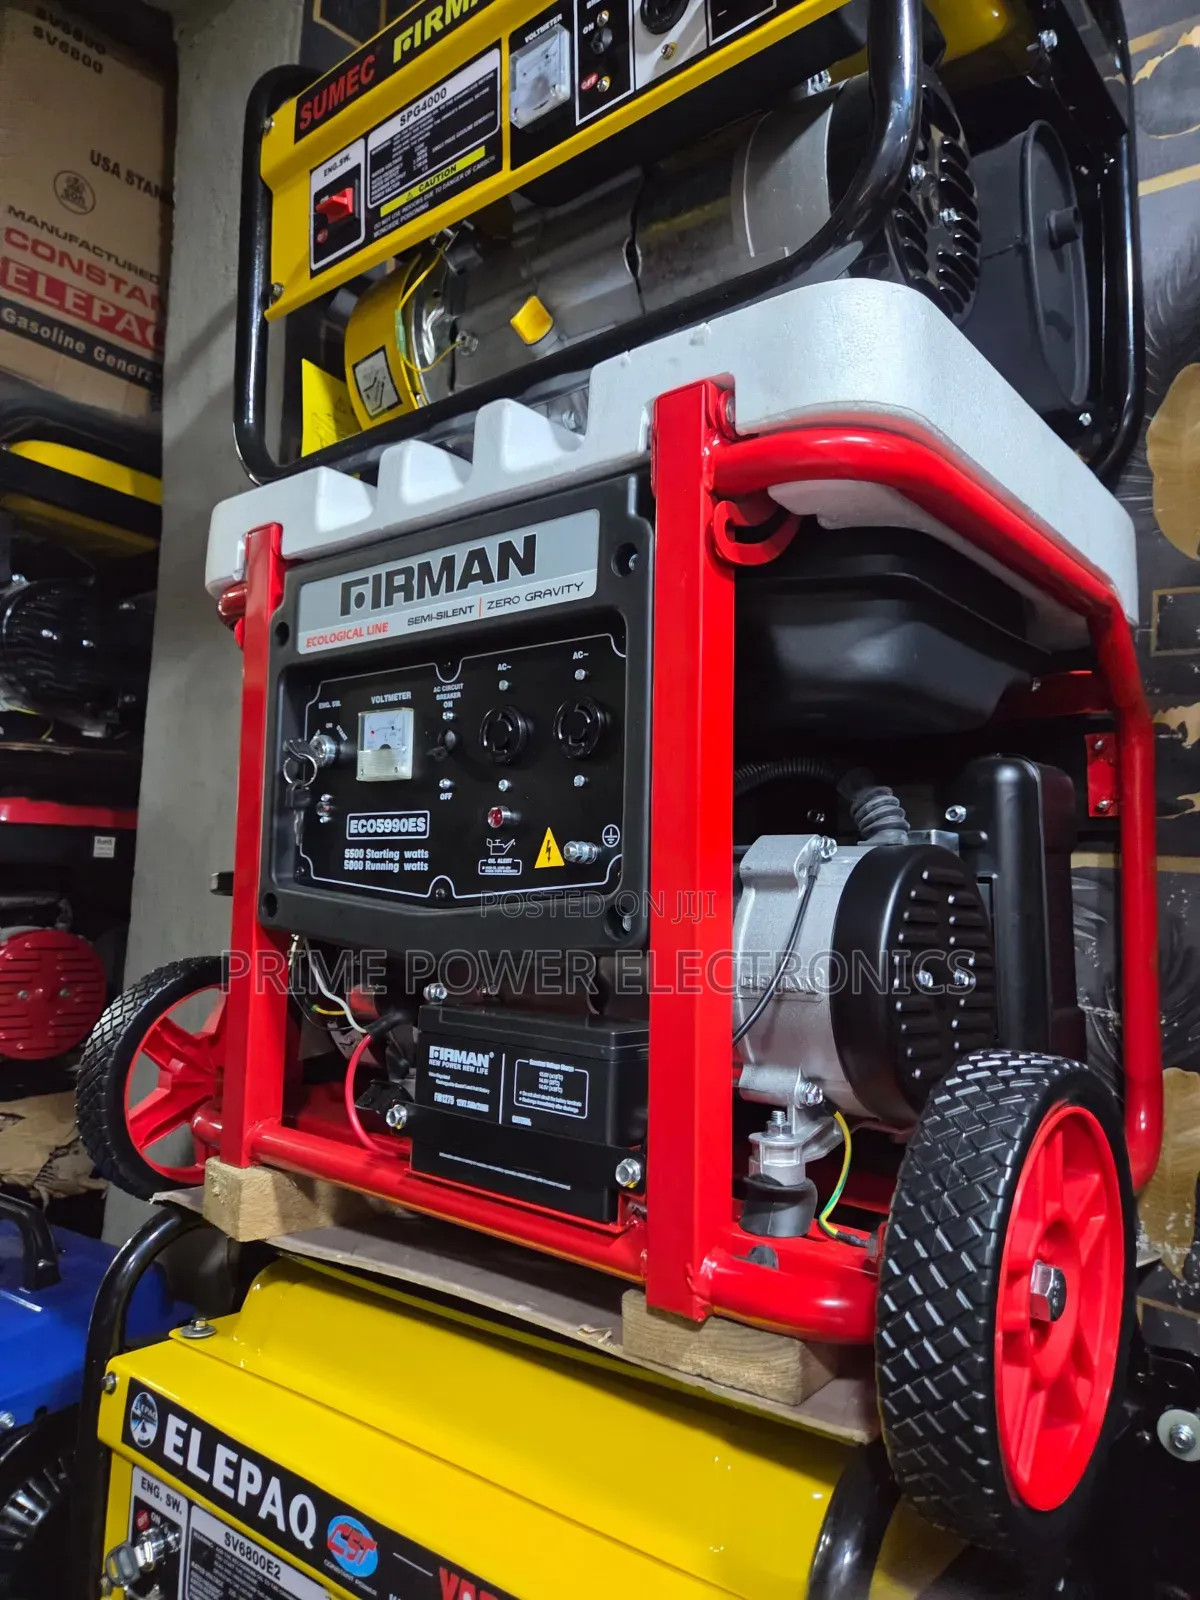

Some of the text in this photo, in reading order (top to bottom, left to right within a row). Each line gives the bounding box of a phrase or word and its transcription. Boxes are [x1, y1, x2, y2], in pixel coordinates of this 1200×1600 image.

[524, 14, 563, 43] VOLTMETER
[300, 55, 376, 130] SUMEC
[400, 87, 447, 126] SPG4000
[90, 149, 120, 180] USA
[418, 164, 457, 193] CAUTION
[8, 205, 160, 285] MANUFACTURED
[1, 307, 86, 354] Gasoline
[340, 533, 537, 616] FIRMAN
[306, 581, 584, 648] ECOLOGICAL LINE SEMI-SILENT ZERO GRAVITY
[371, 691, 412, 704] VOLTMETER
[436, 692, 462, 700] BREAKER
[442, 683, 464, 692] CIRCUIT
[349, 817, 426, 834] ECO5990ES
[344, 848, 429, 861] 5500 Starting watts
[344, 860, 428, 873] 5000 Running watts
[429, 1058, 488, 1076] NEW POWER NEW LIFE
[140, 1476, 182, 1515] ENG. SW.
[163, 1412, 317, 1550] ELEPAQ
[150, 1511, 161, 1526] ON
[224, 1531, 281, 1581] SV6800E2
[327, 1523, 378, 1565] CST
